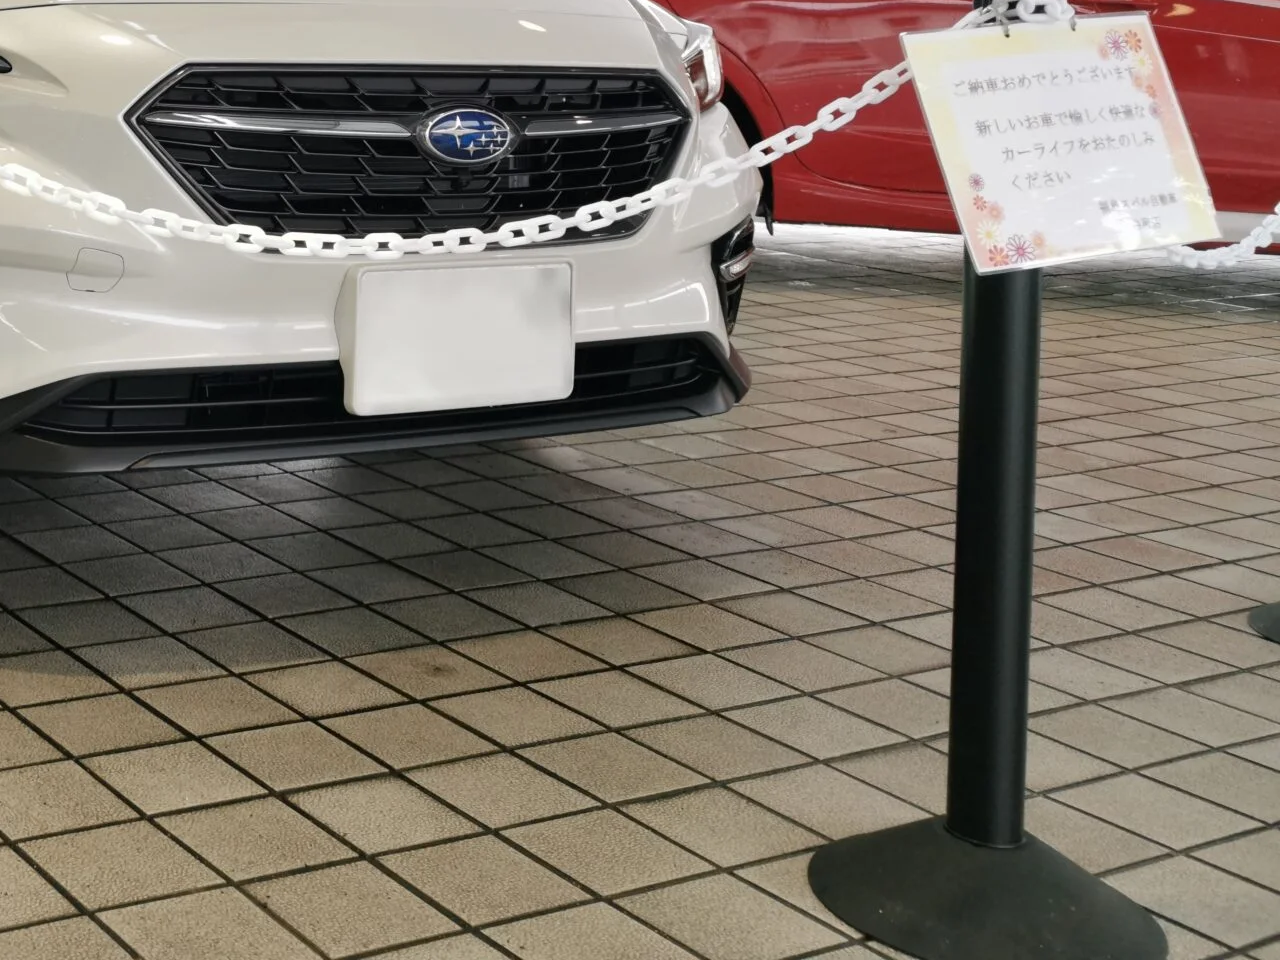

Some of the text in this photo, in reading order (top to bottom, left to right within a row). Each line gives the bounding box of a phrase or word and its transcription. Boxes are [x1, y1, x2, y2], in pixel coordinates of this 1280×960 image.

[952, 66, 1136, 98] ご納車おめでとうございます
[1001, 133, 1155, 163] カーライフをおたのしみ
[1010, 171, 1072, 191] ください
